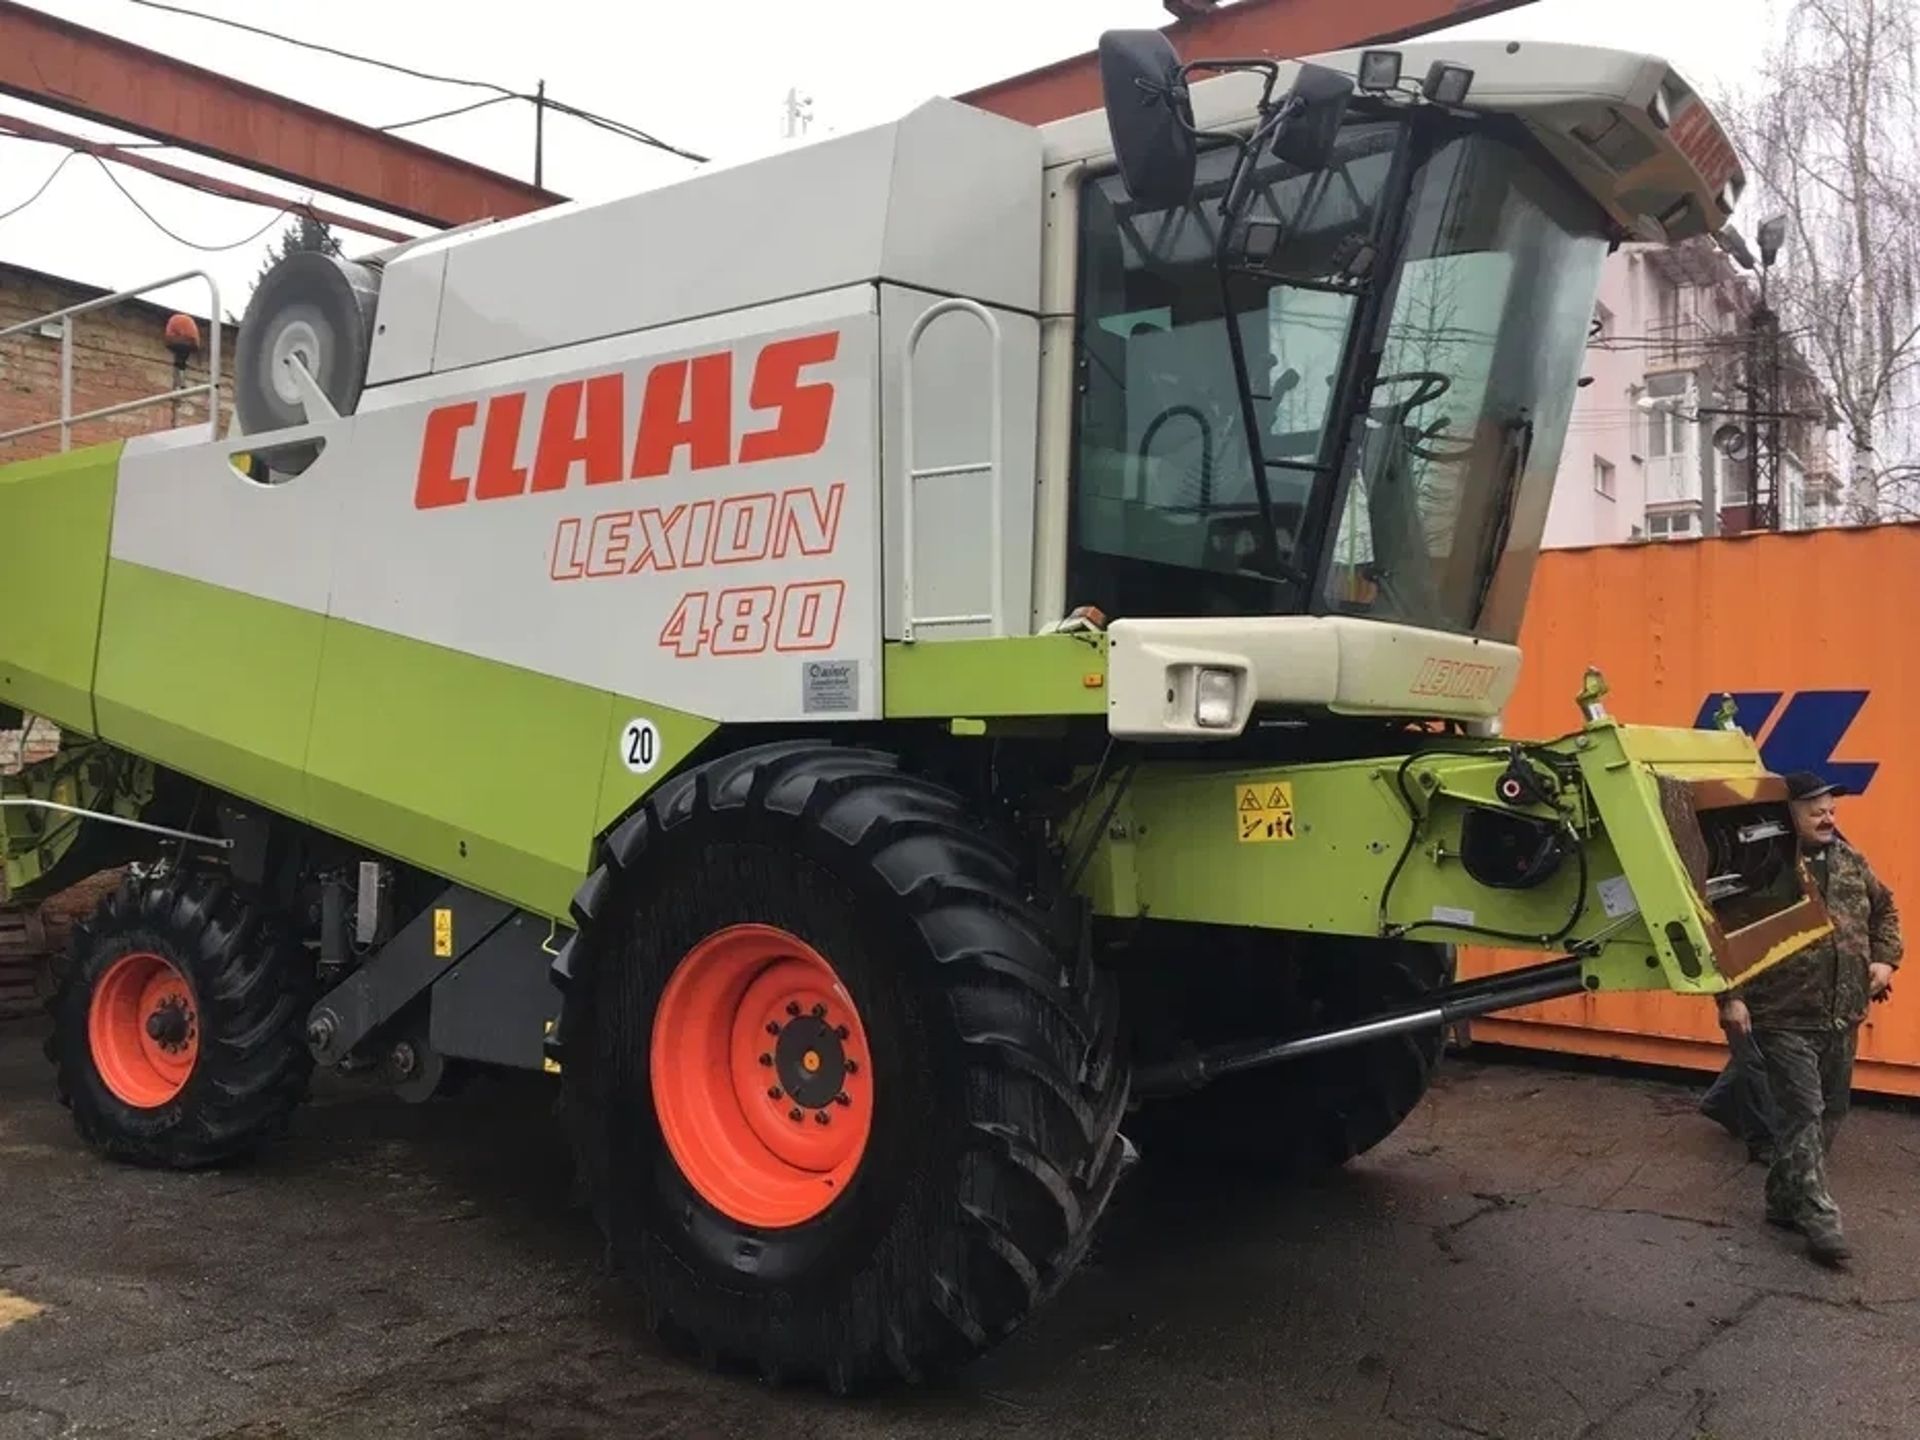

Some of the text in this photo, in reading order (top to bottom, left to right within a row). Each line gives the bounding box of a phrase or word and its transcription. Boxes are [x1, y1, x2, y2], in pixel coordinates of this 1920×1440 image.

[415, 331, 839, 509] CLAAS
[551, 483, 844, 580] LEXION
[660, 580, 844, 657] 480
[629, 728, 653, 764] 20
